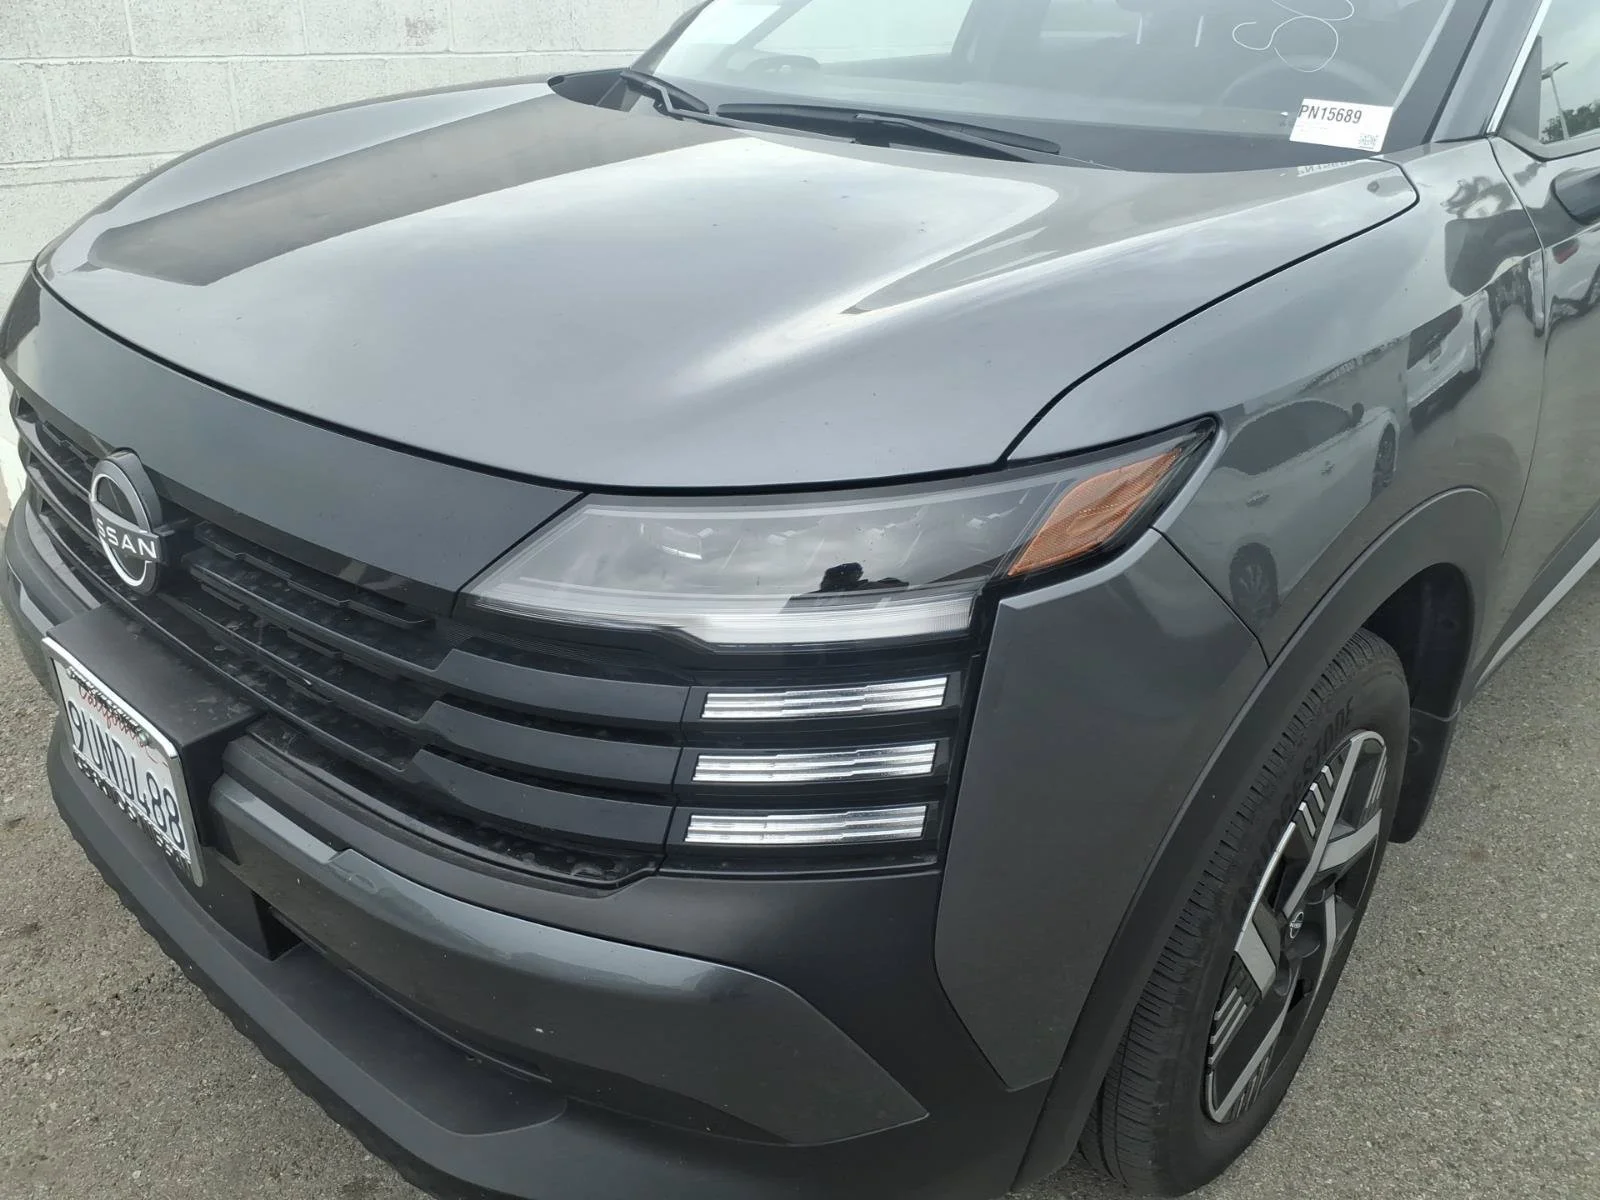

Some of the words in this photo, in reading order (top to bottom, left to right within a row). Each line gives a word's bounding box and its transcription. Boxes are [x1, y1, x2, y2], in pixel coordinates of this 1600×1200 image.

[1298, 105, 1362, 124] PN15689
[97, 518, 157, 559] SSAN
[68, 700, 185, 851] 9UND488
